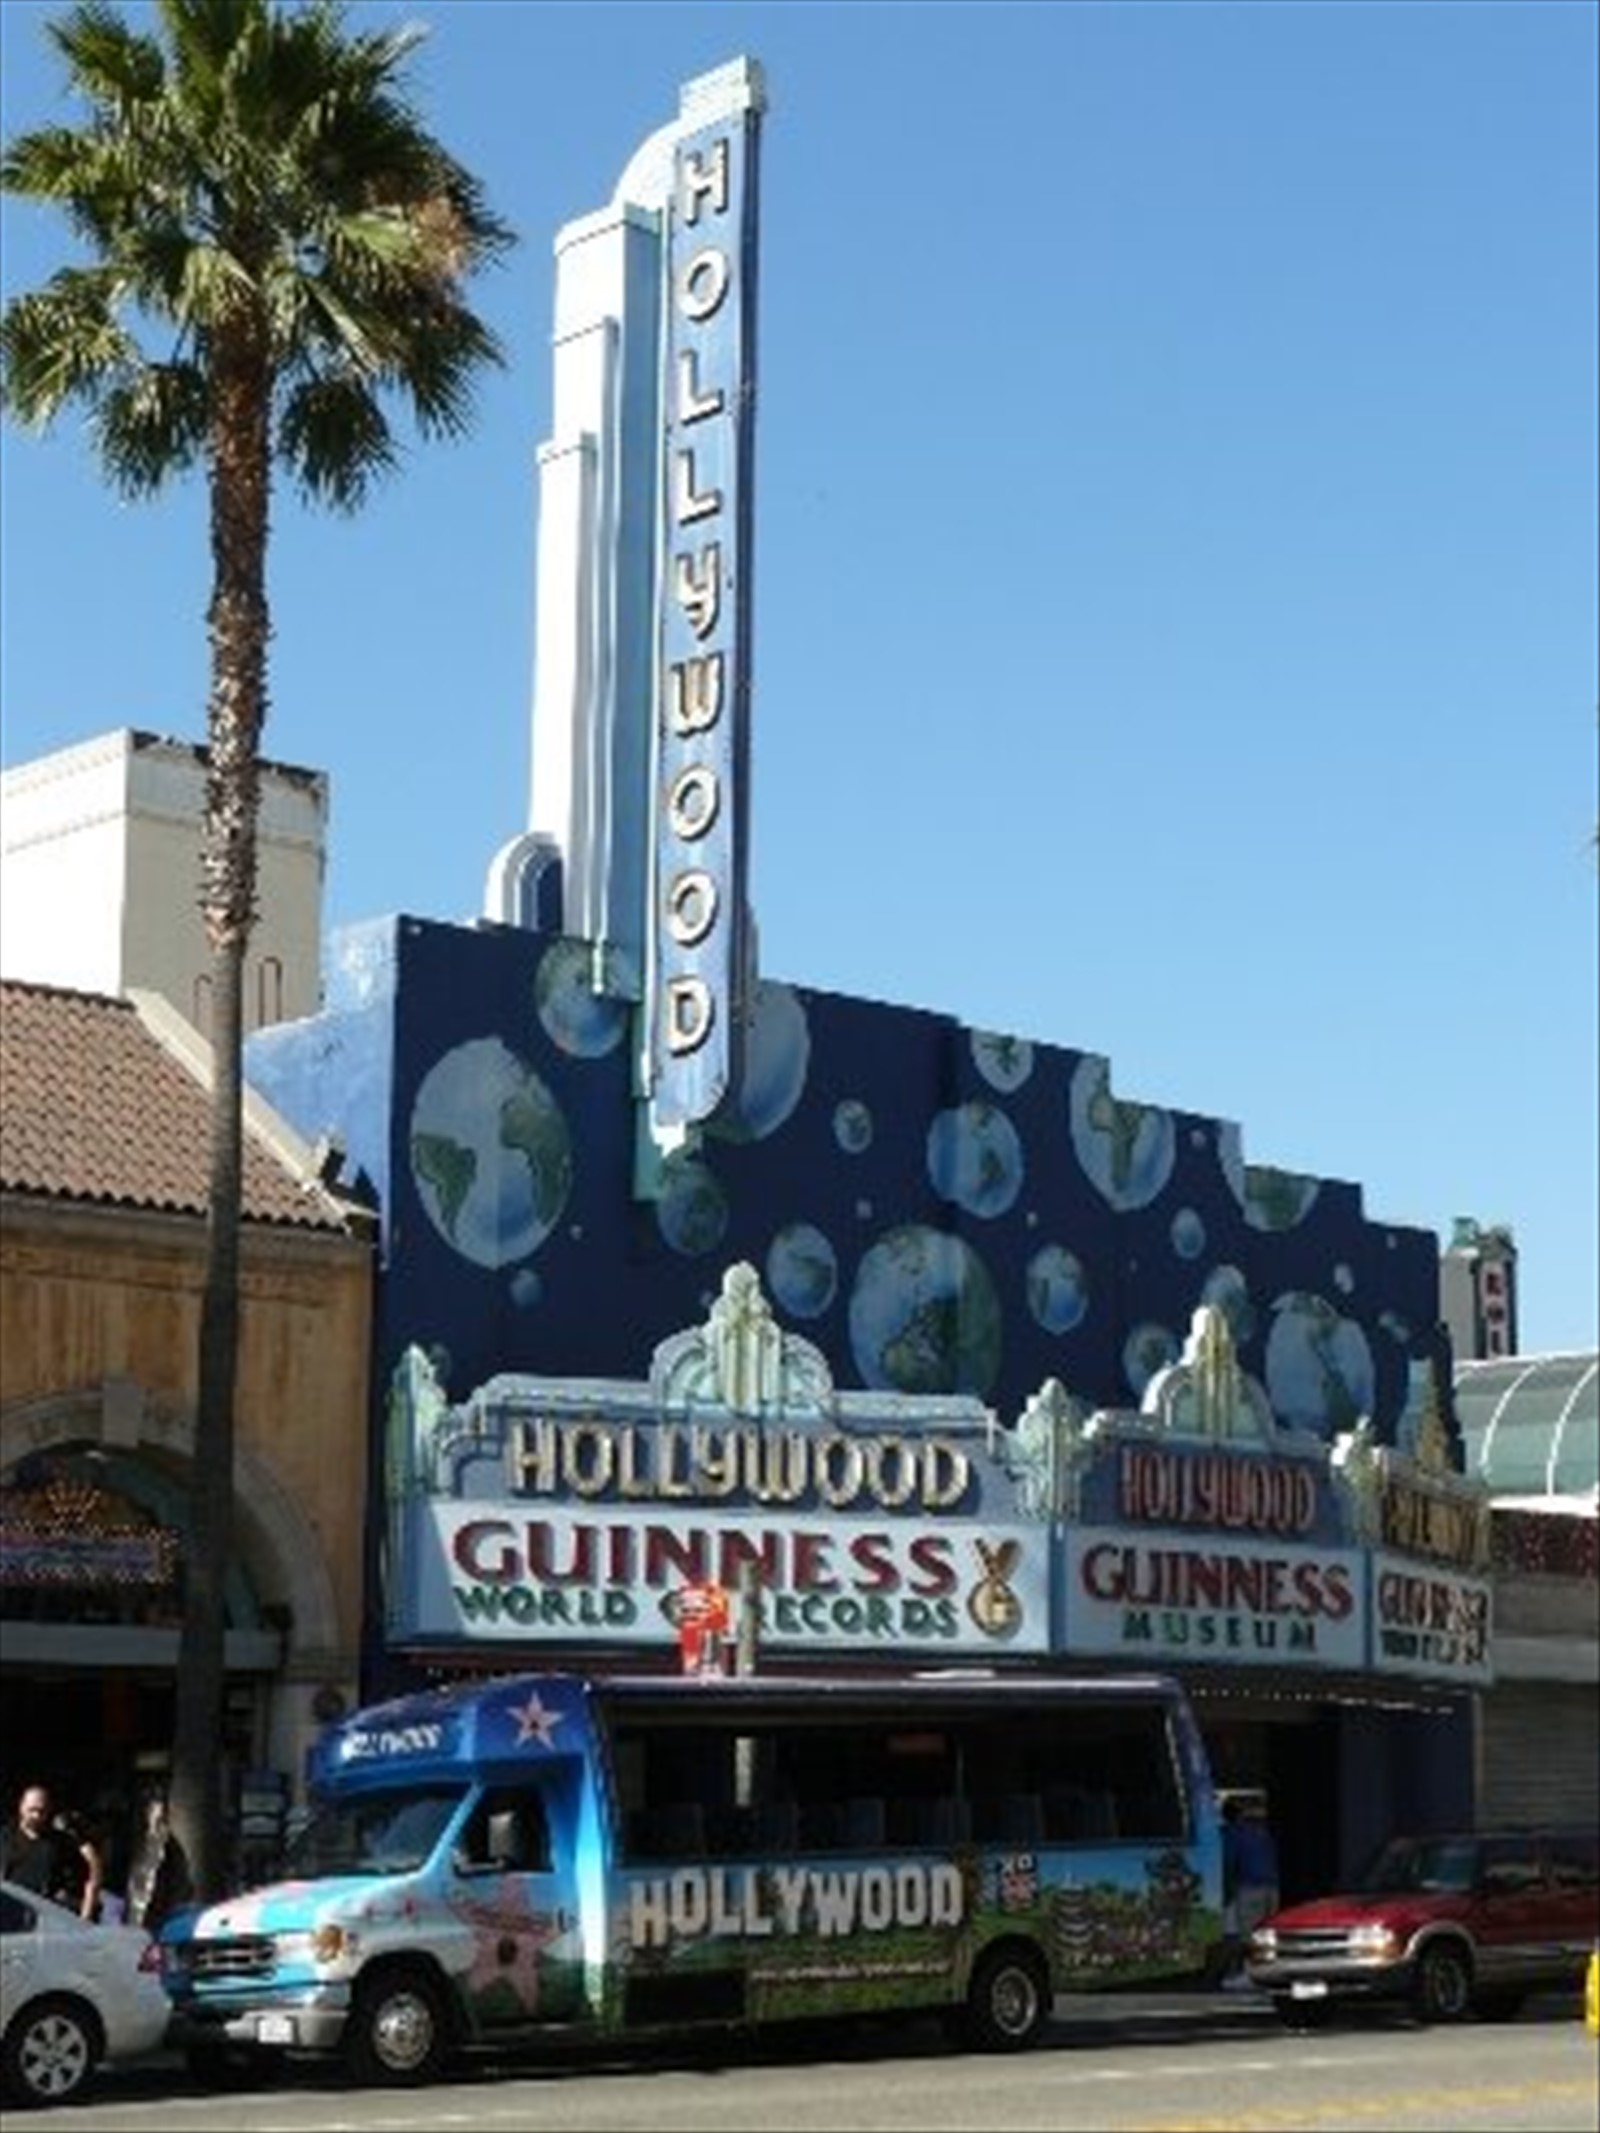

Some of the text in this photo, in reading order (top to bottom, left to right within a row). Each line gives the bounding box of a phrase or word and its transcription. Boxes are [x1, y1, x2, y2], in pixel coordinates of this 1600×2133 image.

[667, 137, 731, 1057] HOLLYWOOD
[510, 1417, 971, 1508] HOLLYWOOD
[1121, 1445, 1317, 1532] HOLLYWOOD
[452, 1519, 959, 1597] GUINNESS
[1082, 1542, 1354, 1626] GUINNESS
[453, 1583, 638, 1628] WORLD
[1122, 1608, 1317, 1653] MUSEUM
[629, 1861, 964, 1948] HOLLYWOOD
